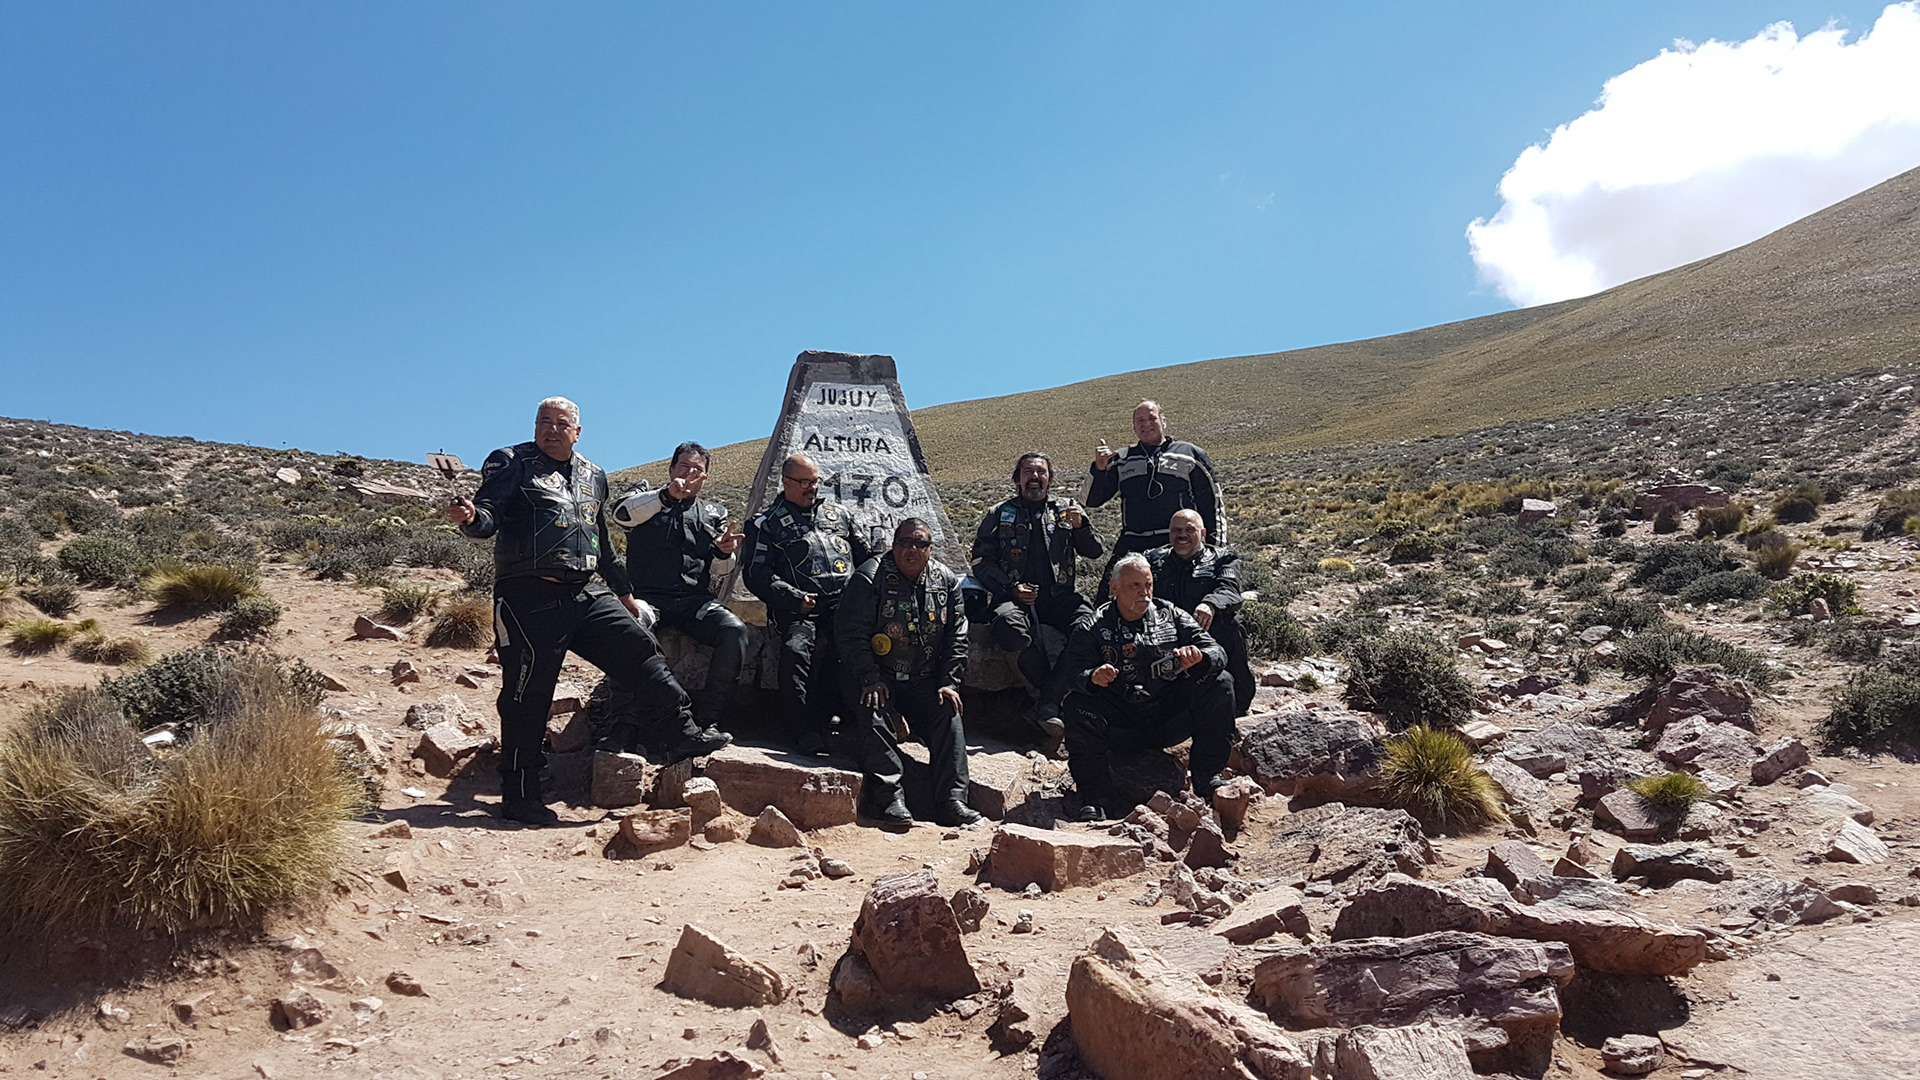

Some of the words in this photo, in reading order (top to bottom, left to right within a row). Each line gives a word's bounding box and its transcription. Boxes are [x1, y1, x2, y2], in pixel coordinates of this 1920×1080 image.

[817, 388, 878, 407] JUJUY
[803, 433, 892, 455] ALTURA
[823, 472, 909, 508] 170
